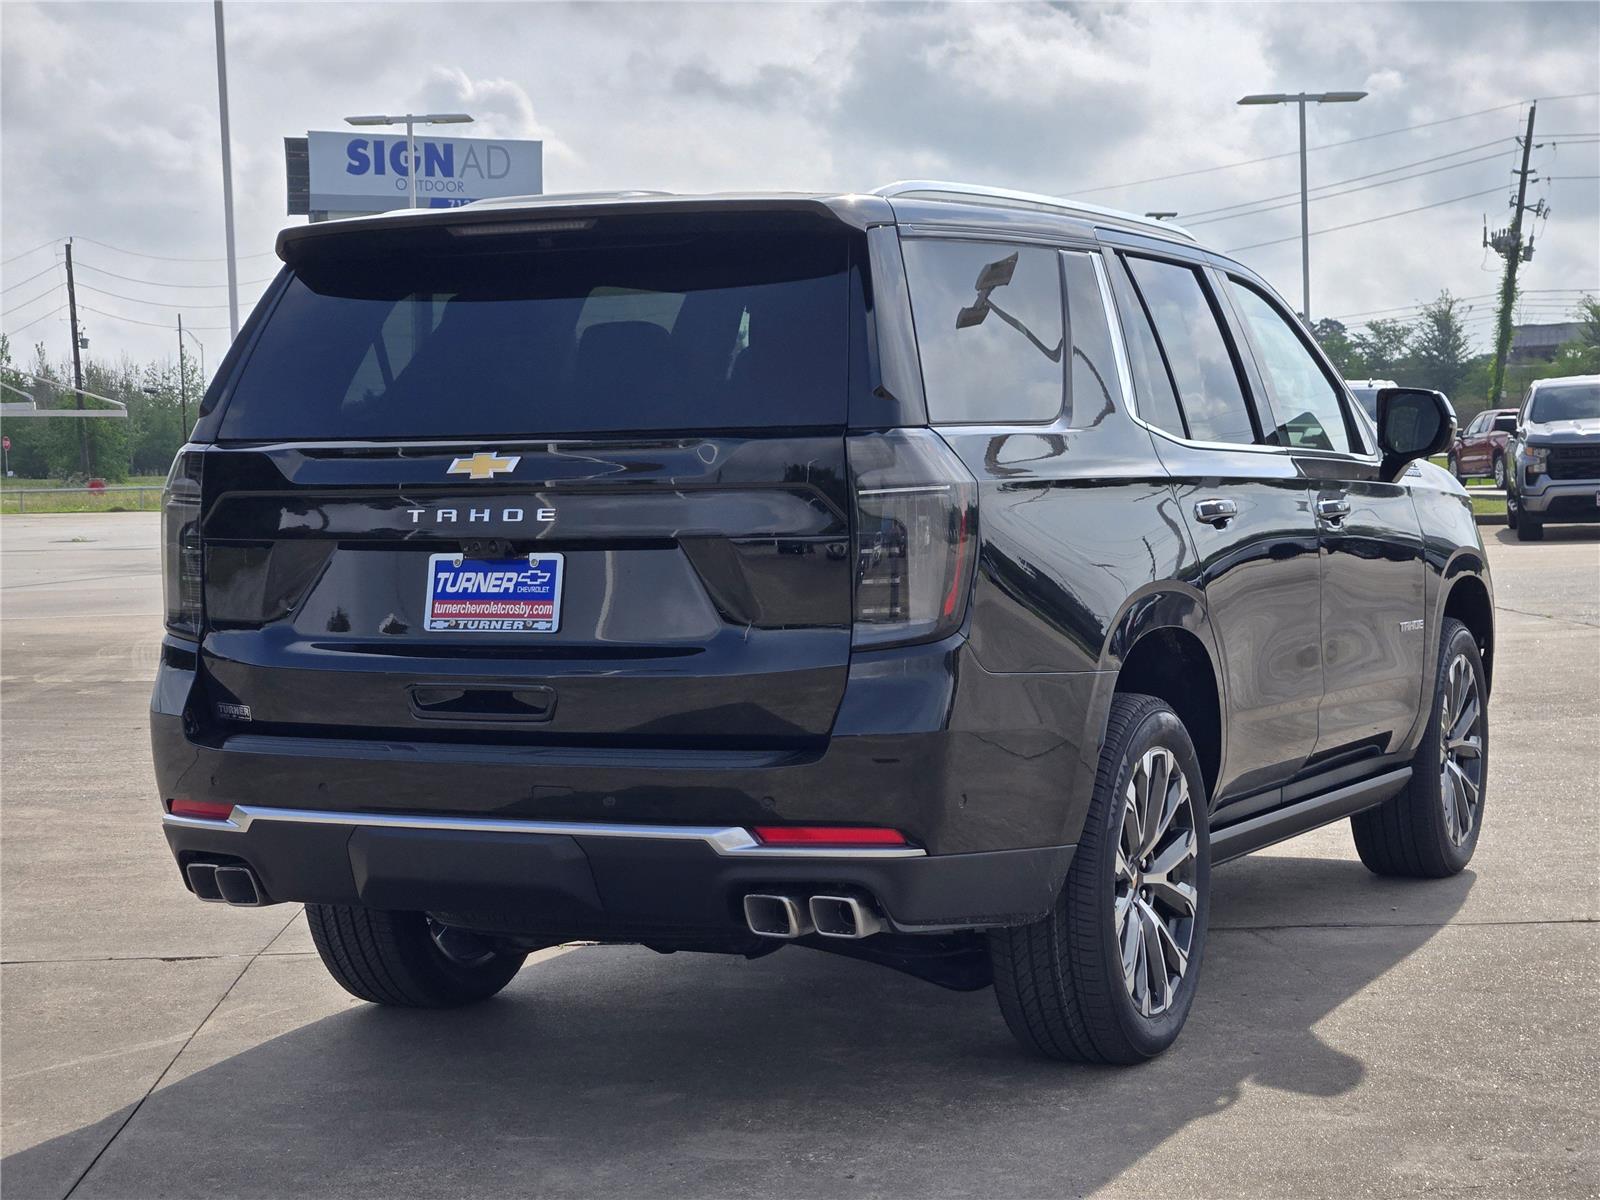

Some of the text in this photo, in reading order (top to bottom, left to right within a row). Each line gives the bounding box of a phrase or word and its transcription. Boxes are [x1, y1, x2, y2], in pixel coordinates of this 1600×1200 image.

[407, 508, 557, 523] TAHOE
[436, 572, 518, 593] TURNER
[434, 601, 553, 618] turnerchevroletcrosby.com
[457, 621, 525, 630] TURNER
[1400, 619, 1424, 632] TAHOE
[219, 704, 250, 717] TURNER
